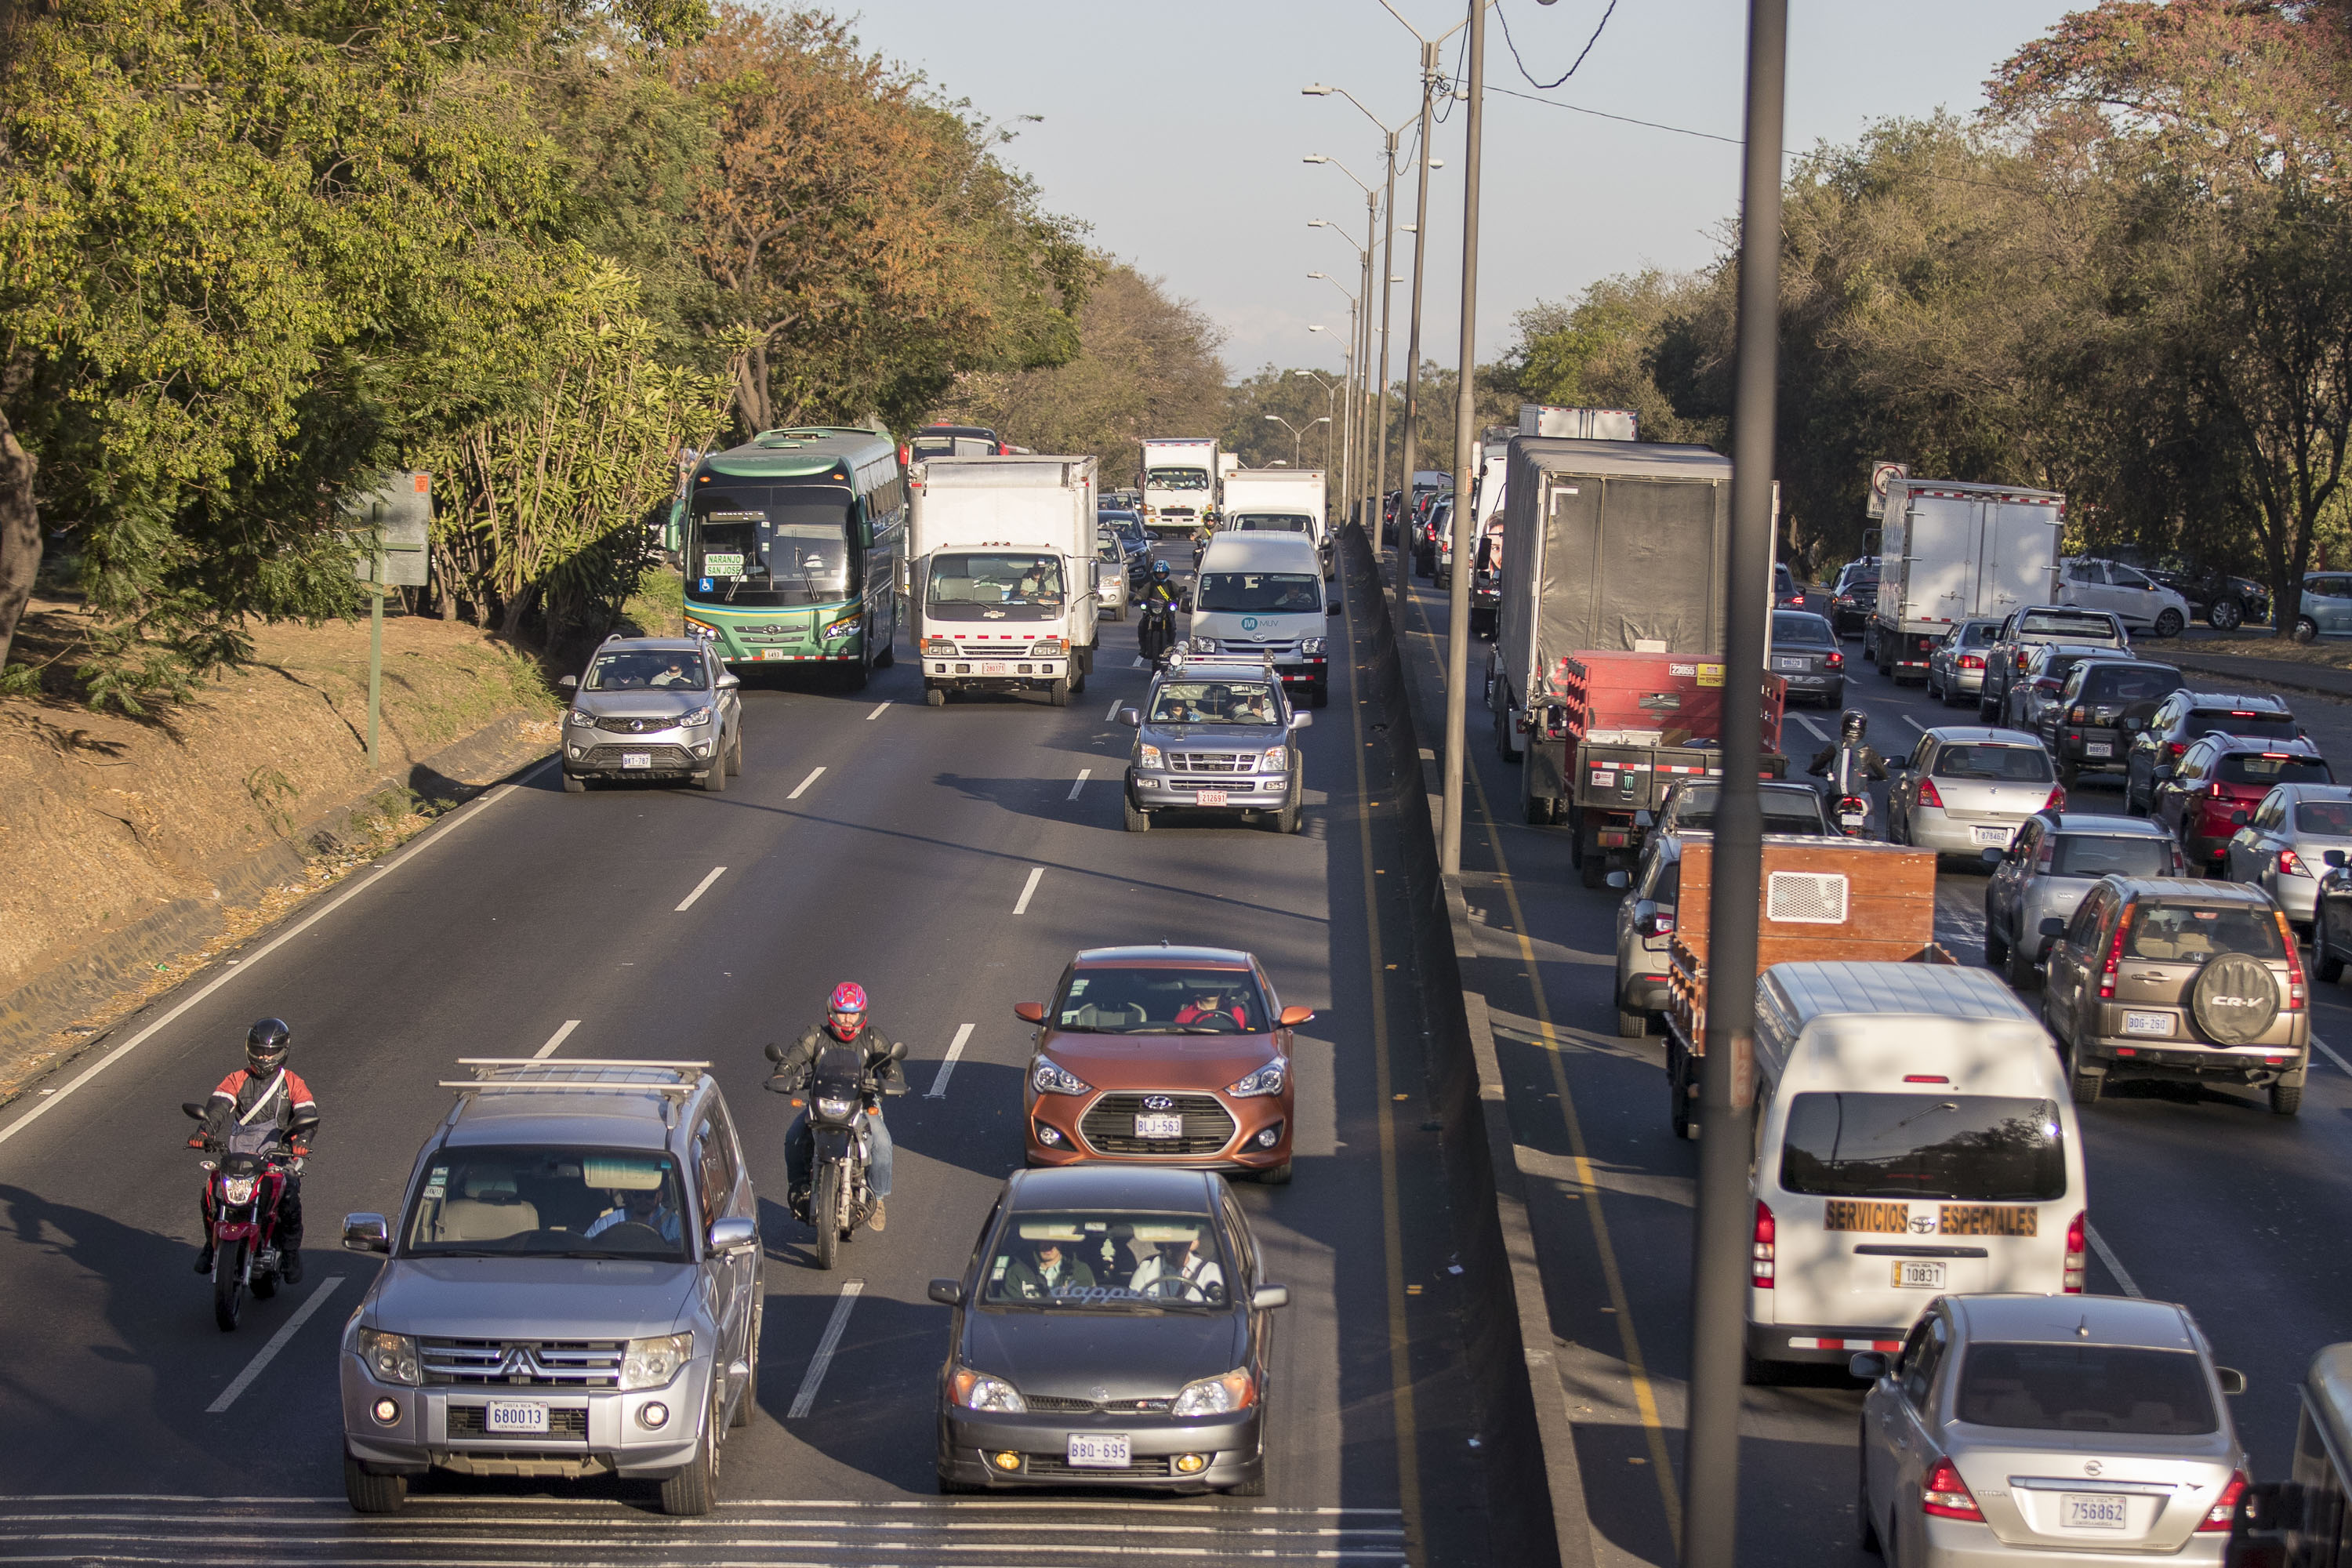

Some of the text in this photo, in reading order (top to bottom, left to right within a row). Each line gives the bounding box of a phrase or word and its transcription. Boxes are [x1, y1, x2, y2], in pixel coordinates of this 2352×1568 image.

[708, 555, 741, 564] NARANJO
[707, 566, 721, 575] SAN
[1671, 665, 1696, 676] 23055
[1203, 794, 1225, 803] 212691
[1981, 832, 2005, 841] 878462
[2212, 996, 2264, 1007] CR-V
[2129, 1018, 2165, 1029] BDG-260
[1138, 1120, 1179, 1132] BLJ-563
[1825, 1200, 2037, 1236] SERVICIOS ESPECIALES
[1907, 1269, 1939, 1282] 10831
[494, 1408, 541, 1424] 680013
[1072, 1443, 1126, 1458] BBQ-695
[2072, 1503, 2122, 1520] 756862
